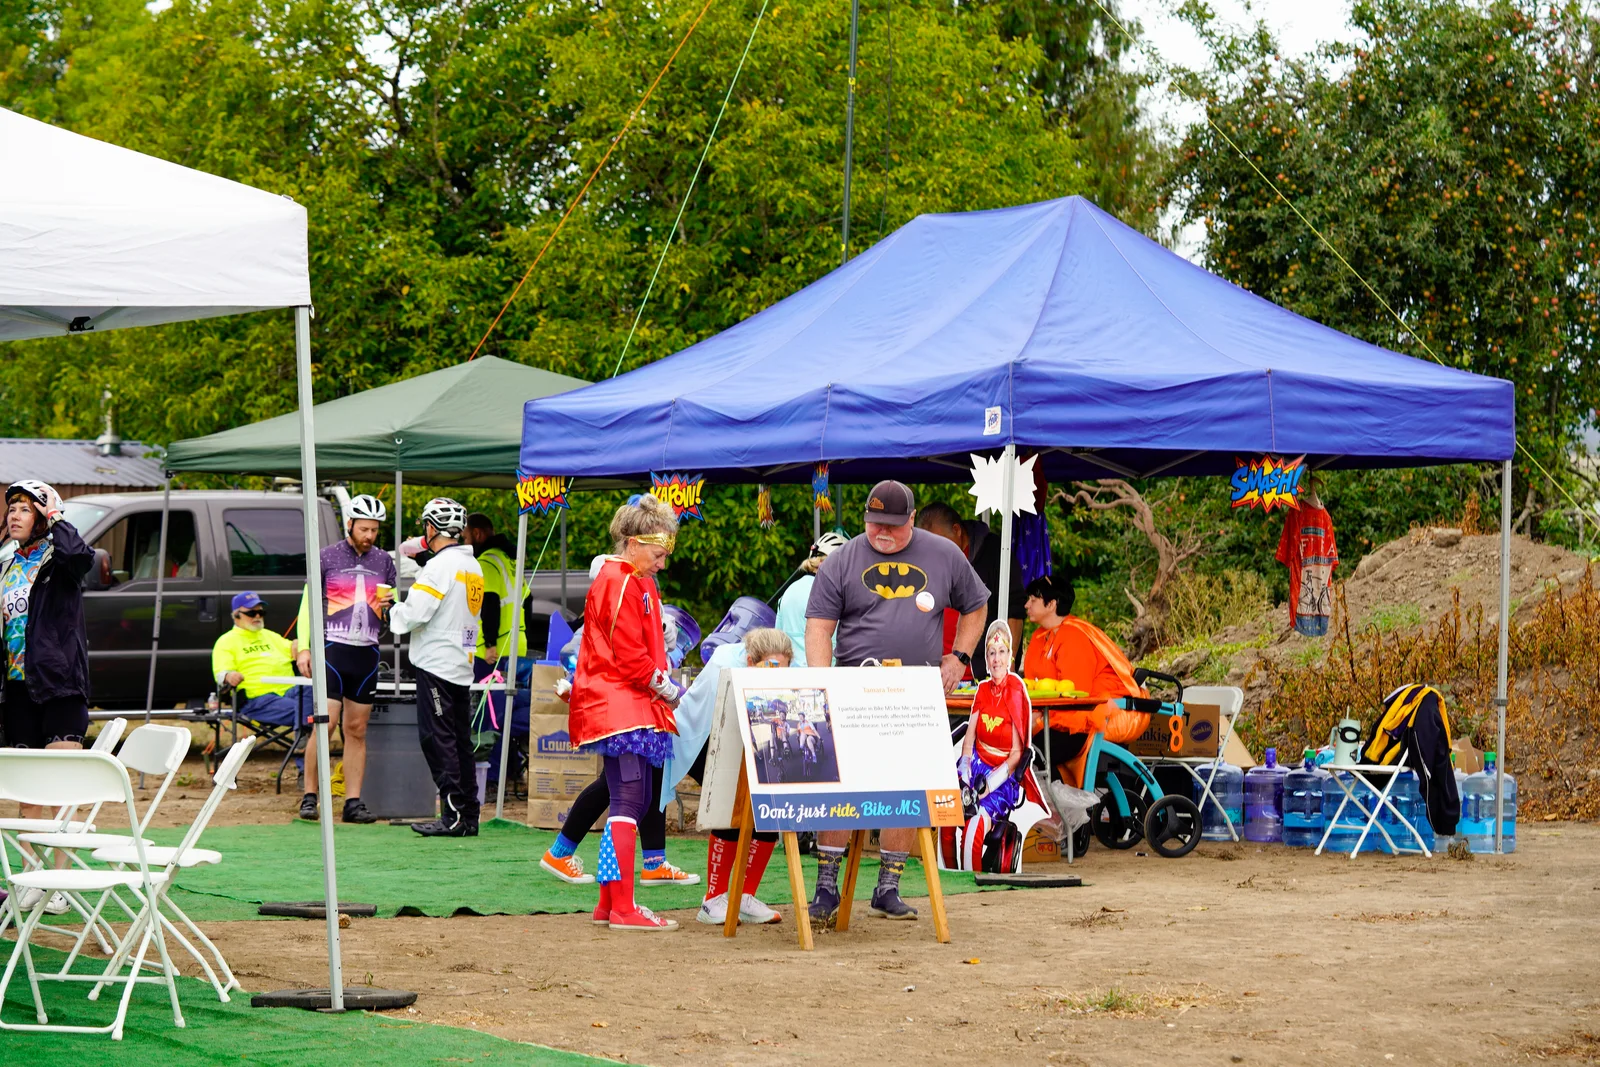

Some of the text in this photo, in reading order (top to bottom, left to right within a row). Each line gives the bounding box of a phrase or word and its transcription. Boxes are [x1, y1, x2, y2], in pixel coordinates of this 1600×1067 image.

[516, 476, 566, 509] KAPOW!
[650, 479, 704, 508] KAPOW!
[1231, 463, 1305, 500] SMASH!
[758, 800, 921, 823] Don't just ride, Bike MS
[935, 795, 955, 808] MS
[709, 838, 725, 894] IGHTER
